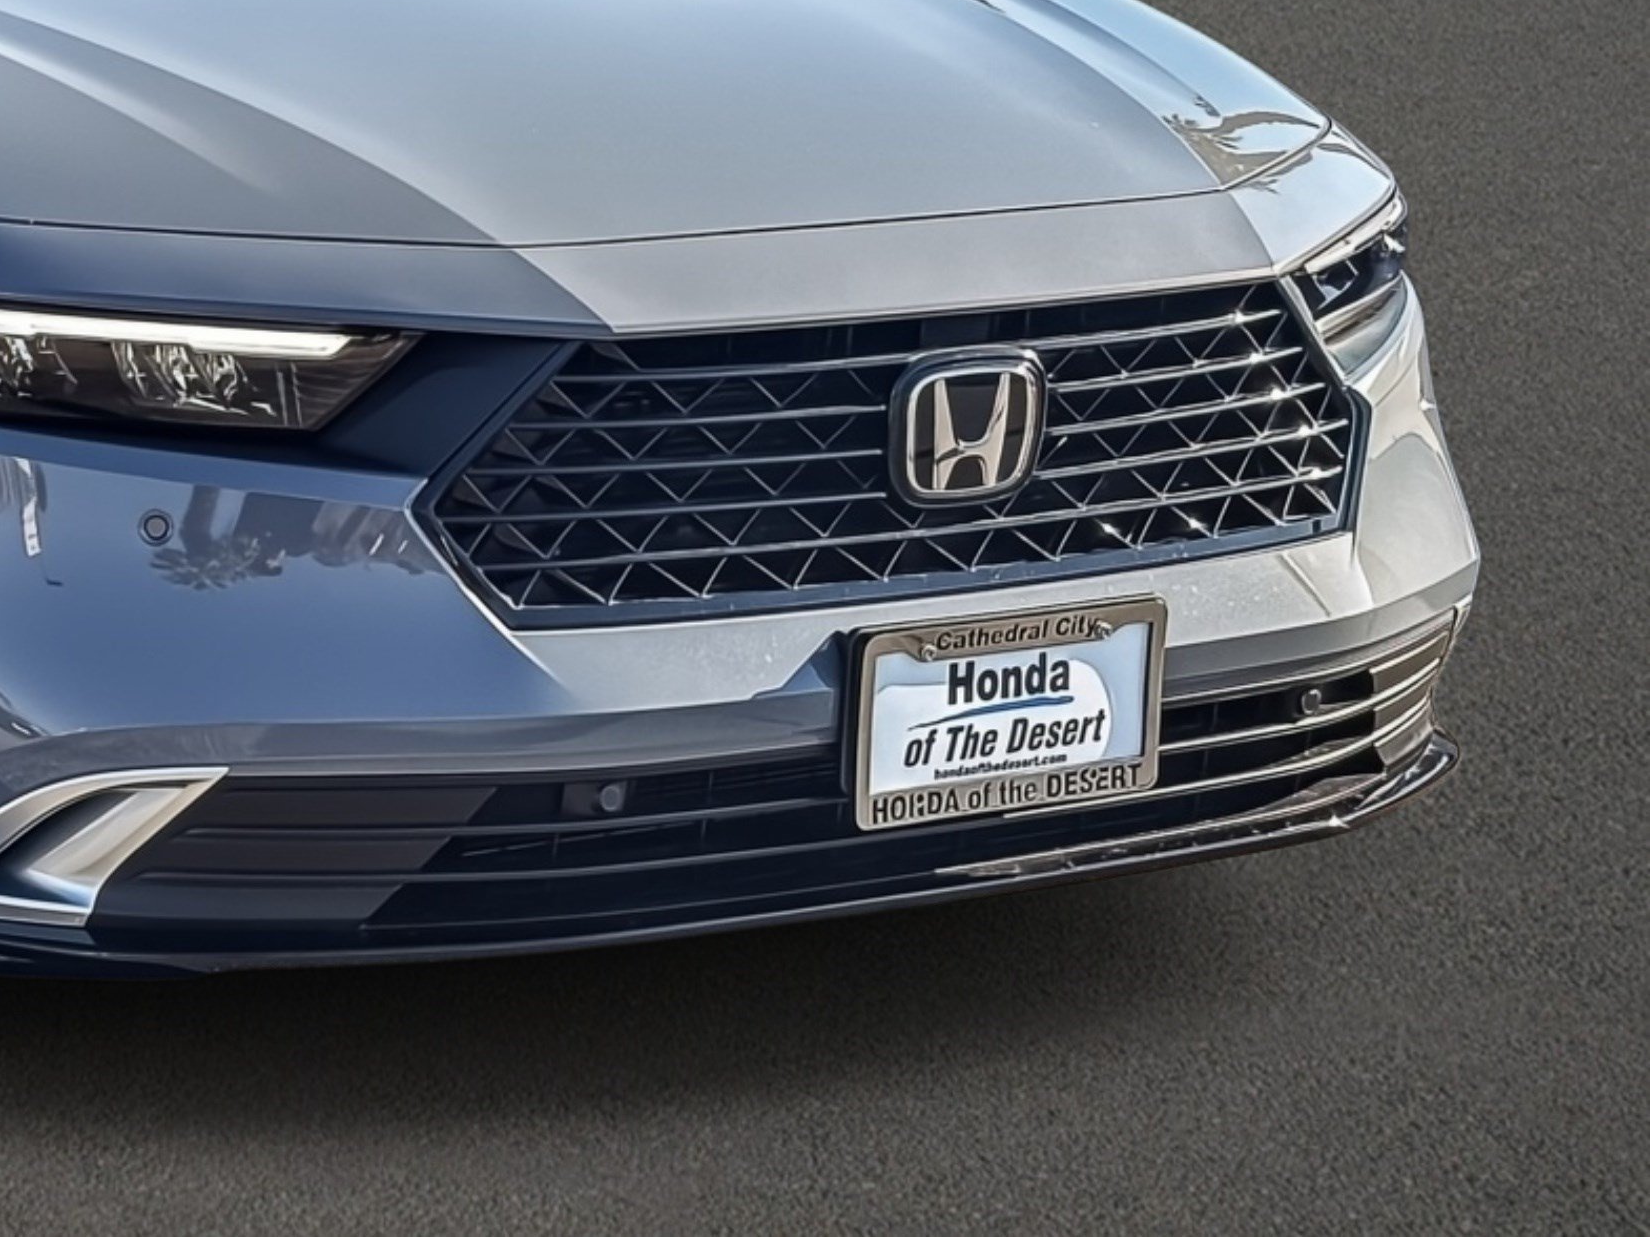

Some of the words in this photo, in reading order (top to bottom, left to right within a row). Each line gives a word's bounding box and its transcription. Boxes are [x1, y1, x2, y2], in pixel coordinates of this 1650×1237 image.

[936, 620, 1049, 650] Cathedral
[1055, 614, 1098, 638] City
[948, 652, 1070, 705] Honda
[904, 729, 938, 767] of
[945, 723, 998, 762] The
[1006, 708, 1105, 753] Desert
[934, 753, 1068, 780] hondaofthedesert.com
[872, 788, 959, 824] HONDA
[968, 781, 991, 809] of
[999, 779, 1037, 805] the
[1047, 763, 1141, 797] DESERT
